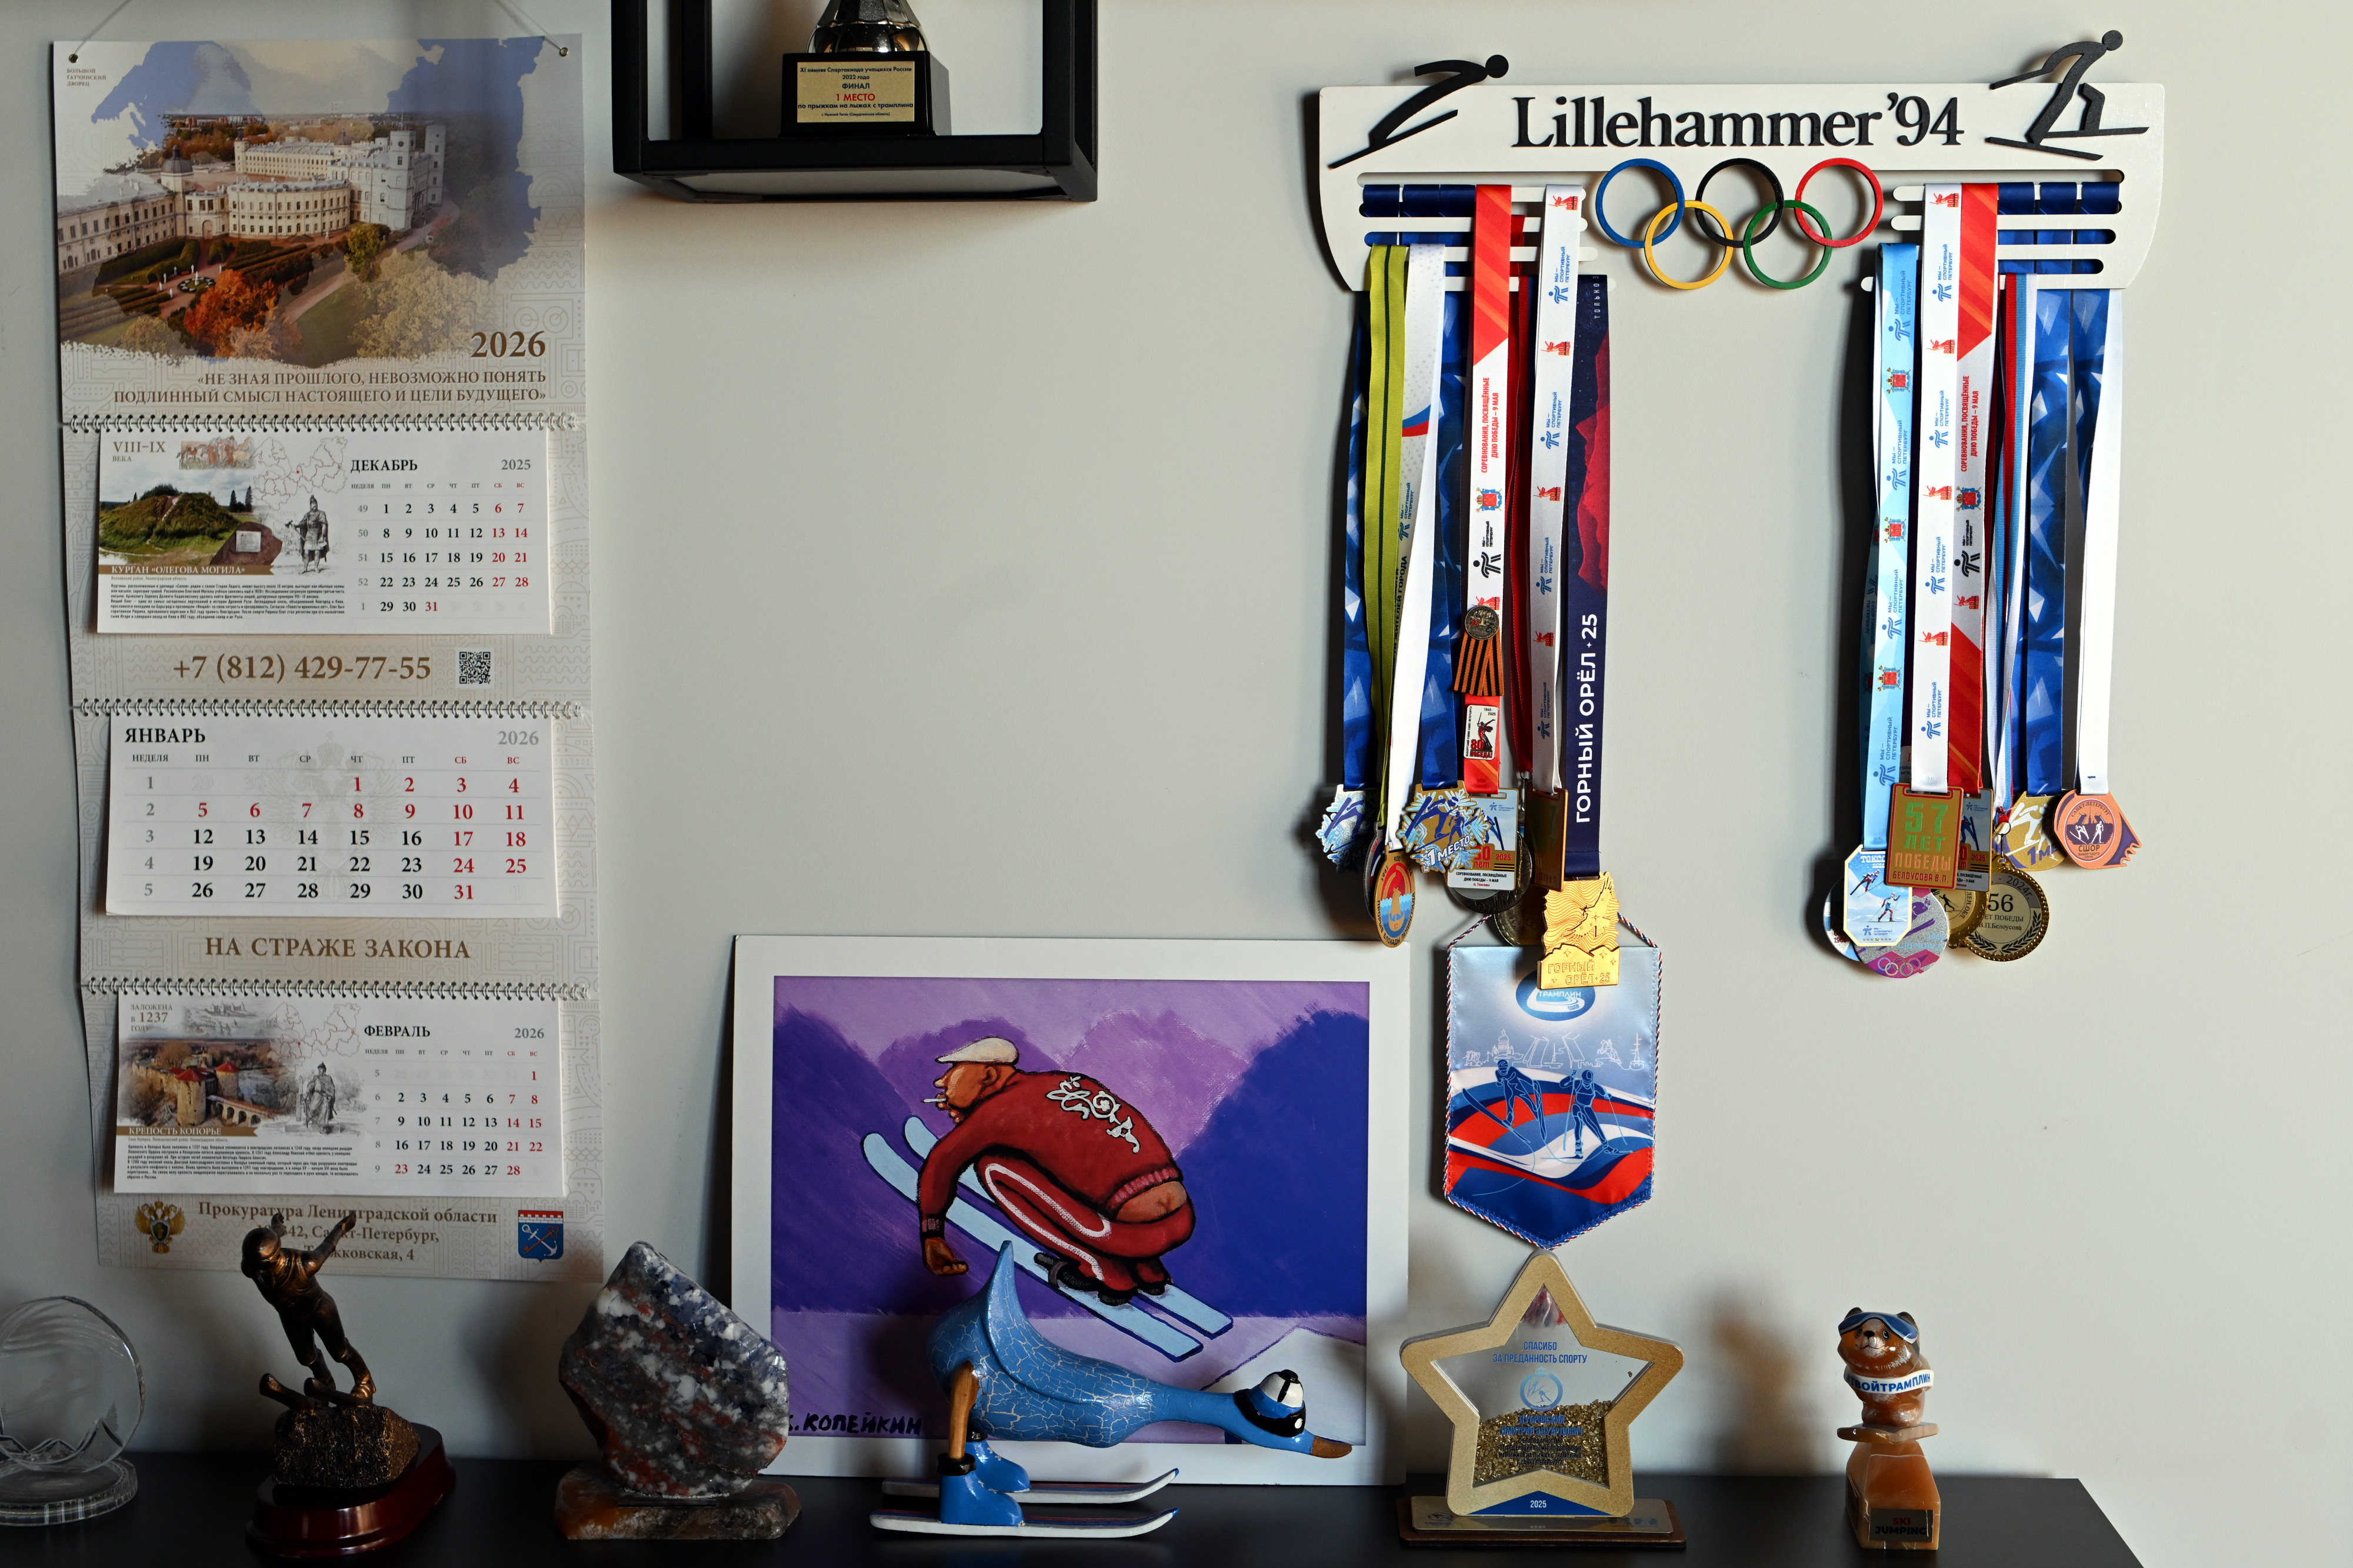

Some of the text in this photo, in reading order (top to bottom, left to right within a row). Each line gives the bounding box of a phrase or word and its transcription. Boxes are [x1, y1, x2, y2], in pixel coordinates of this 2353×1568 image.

[843, 93, 876, 101] МЕСТО
[1554, 273, 1559, 282] МЫ
[1938, 271, 1942, 281] МЫ
[471, 330, 546, 358] 2026
[198, 371, 546, 385] «НЕ ЗНАЯ ПРОШЛОГО, НЕВОЗМОЖНО ПОНЯТЬ
[114, 389, 546, 404] ПОДЛИННЫЙ СМЫСЛ НАСТОЯЩЕГО И ЦЕЛИ БУДУЩЕГО»
[1481, 377, 1489, 423] ПОСВЯЩЁННЫЕ
[1491, 417, 1499, 442] ПОБЕДЫ
[1961, 375, 1969, 472] СОРЕВНОВАНИЯ, ПОСВЯЩЁННЫЕ
[350, 459, 531, 473] ДЕКАБРЬ 2025
[111, 565, 245, 574] КУРГАН «ОЛЕГОВА МОГИЛА»
[1398, 555, 1407, 595] ГОРОДА
[174, 653, 431, 684] +7 (812) 429-77-55
[1575, 613, 1598, 823] ГОРНЫЙ ОРЁЛ 25
[125, 728, 539, 745] ЯНВАРЬ 2026
[1471, 739, 1484, 750] 80
[132, 754, 168, 762] НЕДЕЛЯ
[350, 755, 363, 763] ЧТ
[402, 756, 415, 764] ПТ
[2071, 802, 2110, 817] САНКТ-ПЕТЕРБУРГ
[1905, 802, 1948, 834] 57
[194, 829, 526, 847] 12 13 14 15 16 17 18
[1903, 834, 1945, 851] ЛЕТ
[1427, 835, 1471, 866] 1 МЕСТО
[1894, 852, 1951, 872] ПОБЕДЫ
[1381, 865, 1389, 882] 1941
[1893, 870, 1933, 882] БЕЛОУСОВА
[2007, 876, 2033, 900] 2024г.
[1988, 893, 2014, 912] 56
[1401, 891, 1415, 939] ЛЕНИНГРАДА
[1383, 932, 1401, 946] БЛОКАДЫ
[205, 937, 471, 959] НА СТРАЖЕ ЗАКОНА
[1548, 959, 1595, 974] ГОРНЫЙ
[1565, 972, 1611, 985] ОРЁЛ 25
[139, 1012, 168, 1023] 1237
[364, 1025, 545, 1039] ФЕВРАЛЬ 2026
[129, 1127, 222, 1135] КРЕПОСТЬ КОПОРЬЕ
[199, 1202, 497, 1224] Прокуратура Лениградской области
[406, 1249, 414, 1260] 4
[1524, 1342, 1558, 1351] СПАСИБО
[1493, 1354, 1588, 1364] ЗА ПРЕДАННОСТЬ СПОРТУ
[1518, 1414, 1565, 1424] ДУБРОВСКИЙ
[1501, 1426, 1583, 1436] ДМИТРИЙ ЭДУАРДОВИЧ
[1530, 1500, 1547, 1509] 2025
[1892, 1517, 1911, 1526] SKI
[1875, 1526, 1927, 1535] JUMPING
